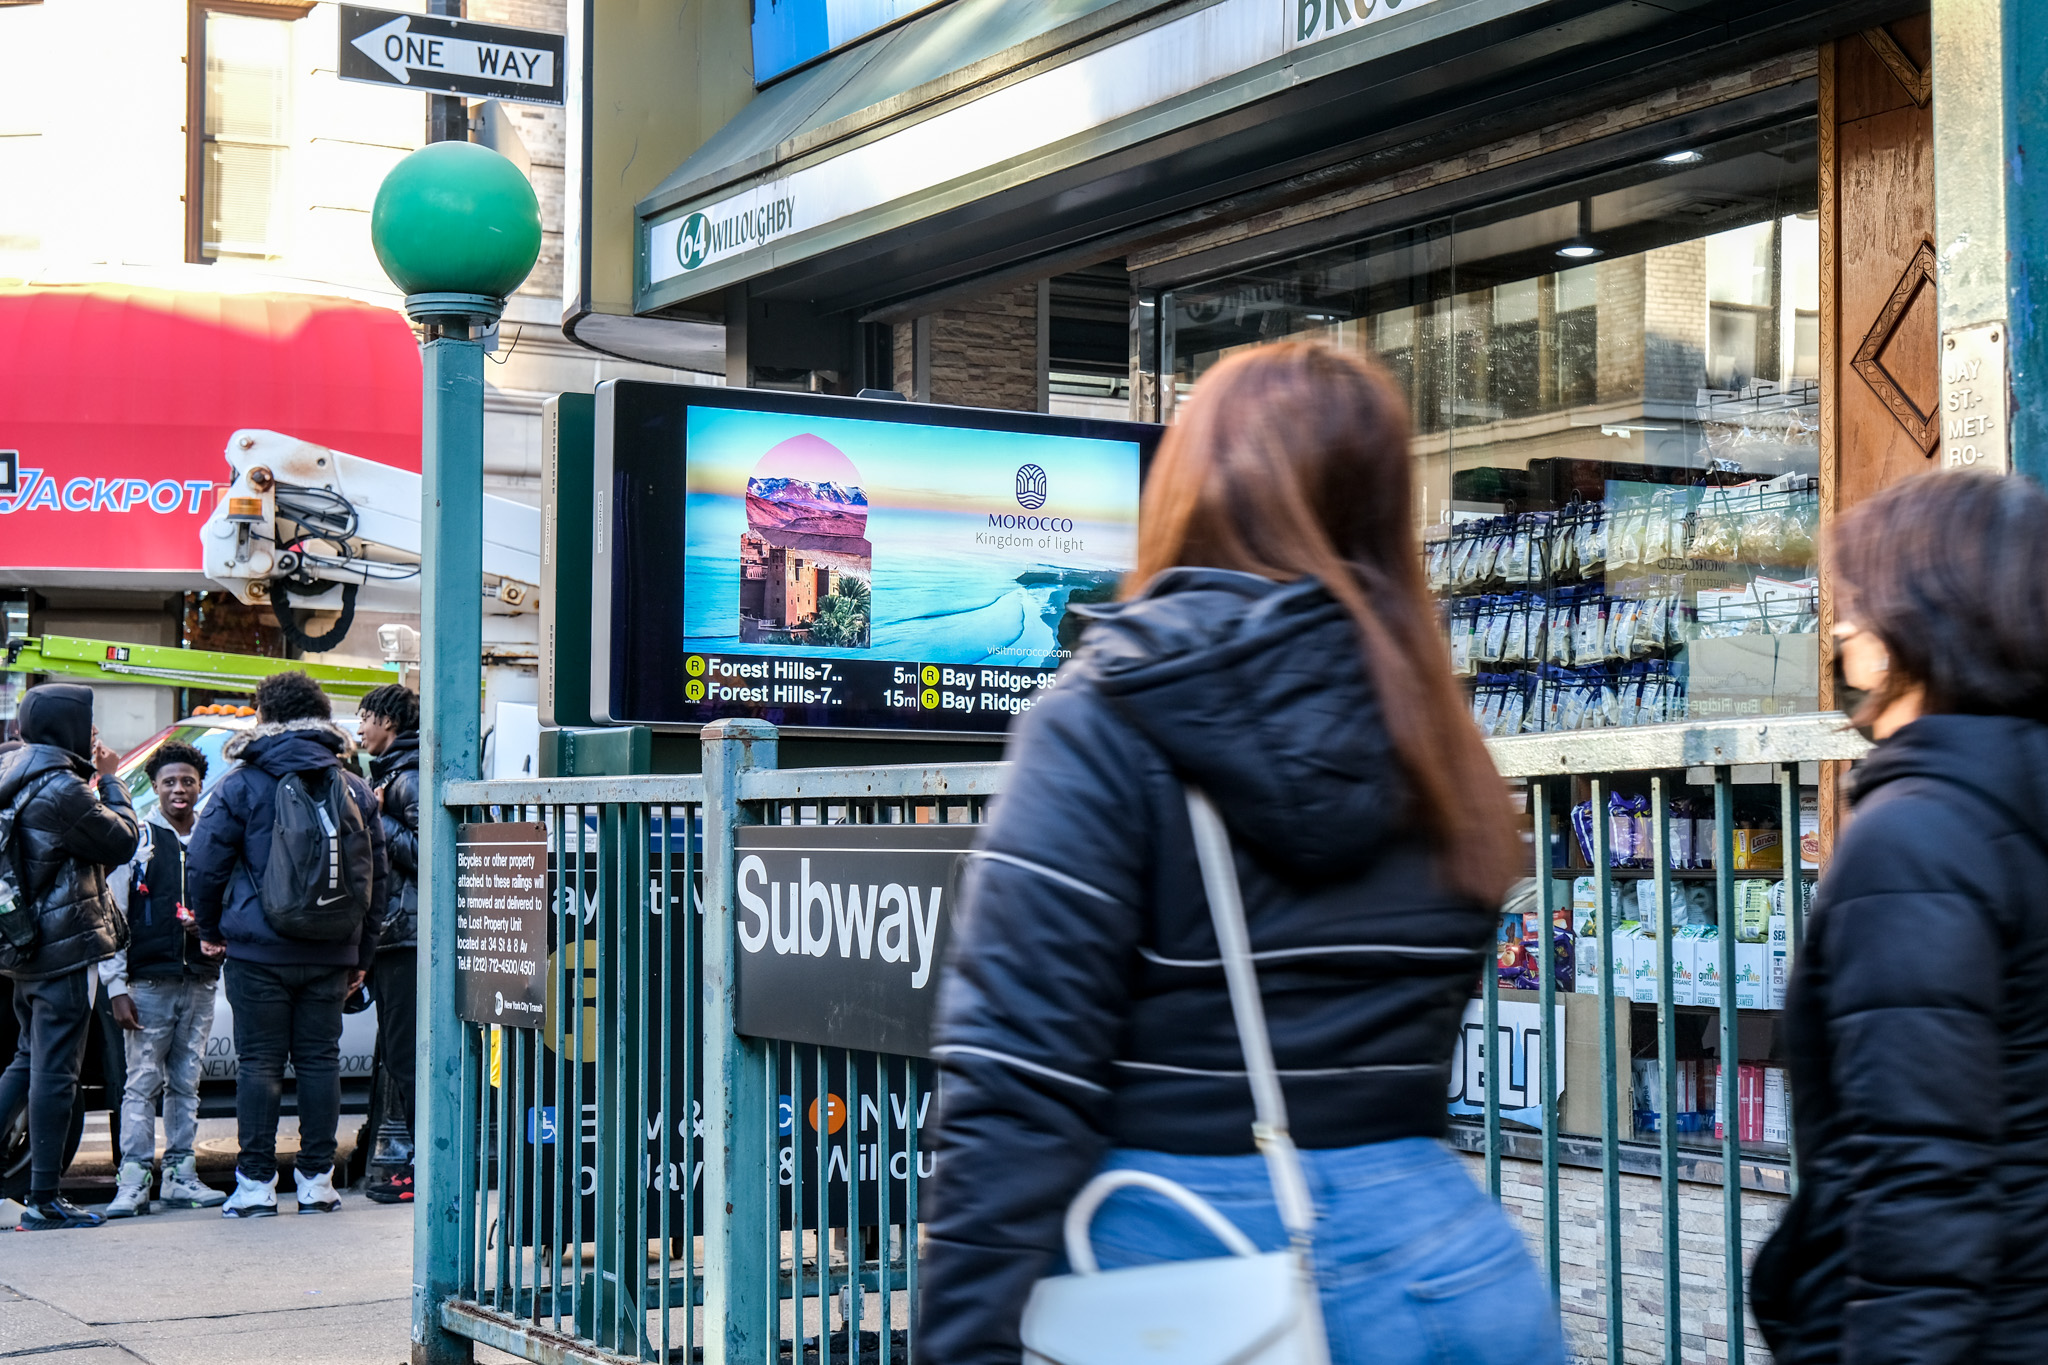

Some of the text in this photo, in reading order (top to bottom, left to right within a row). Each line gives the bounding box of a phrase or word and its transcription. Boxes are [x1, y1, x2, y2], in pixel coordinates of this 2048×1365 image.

[384, 34, 542, 80] ONE WAY
[679, 195, 796, 265] 64 WILLOUGHBY
[1947, 359, 1982, 385] JAY
[1948, 414, 1995, 440] MET-
[1949, 444, 1985, 467] RO-
[0, 468, 213, 515] JACKPOT
[988, 514, 1073, 533] MOROCCO
[975, 532, 1084, 553] Kingdom of light
[986, 645, 1071, 658] visitmorocco.com
[708, 658, 769, 678] Forest
[774, 661, 843, 682] Hills-7..
[893, 666, 917, 685] 5m
[942, 668, 976, 690] Bay
[981, 670, 1057, 693] Ridge-95
[708, 682, 768, 702] Forest
[773, 685, 843, 705] Hills-7..
[883, 690, 917, 708] 15m
[942, 691, 976, 713] Bay
[981, 693, 1043, 715] Ridge-
[1752, 834, 1777, 849] Lance
[458, 852, 535, 870] Bicycles or other property
[458, 873, 545, 892] attached to these railings will
[458, 894, 542, 911] be removed and delivered to
[458, 914, 522, 933] the Lost Property Unit
[737, 854, 943, 989] Subway
[457, 935, 528, 953] located at 34 St & 8 Av
[473, 956, 487, 973] (212)
[504, 1000, 512, 1010] New
[512, 1000, 520, 1010] York
[521, 1001, 529, 1013] City
[338, 1054, 374, 1073] 0010
